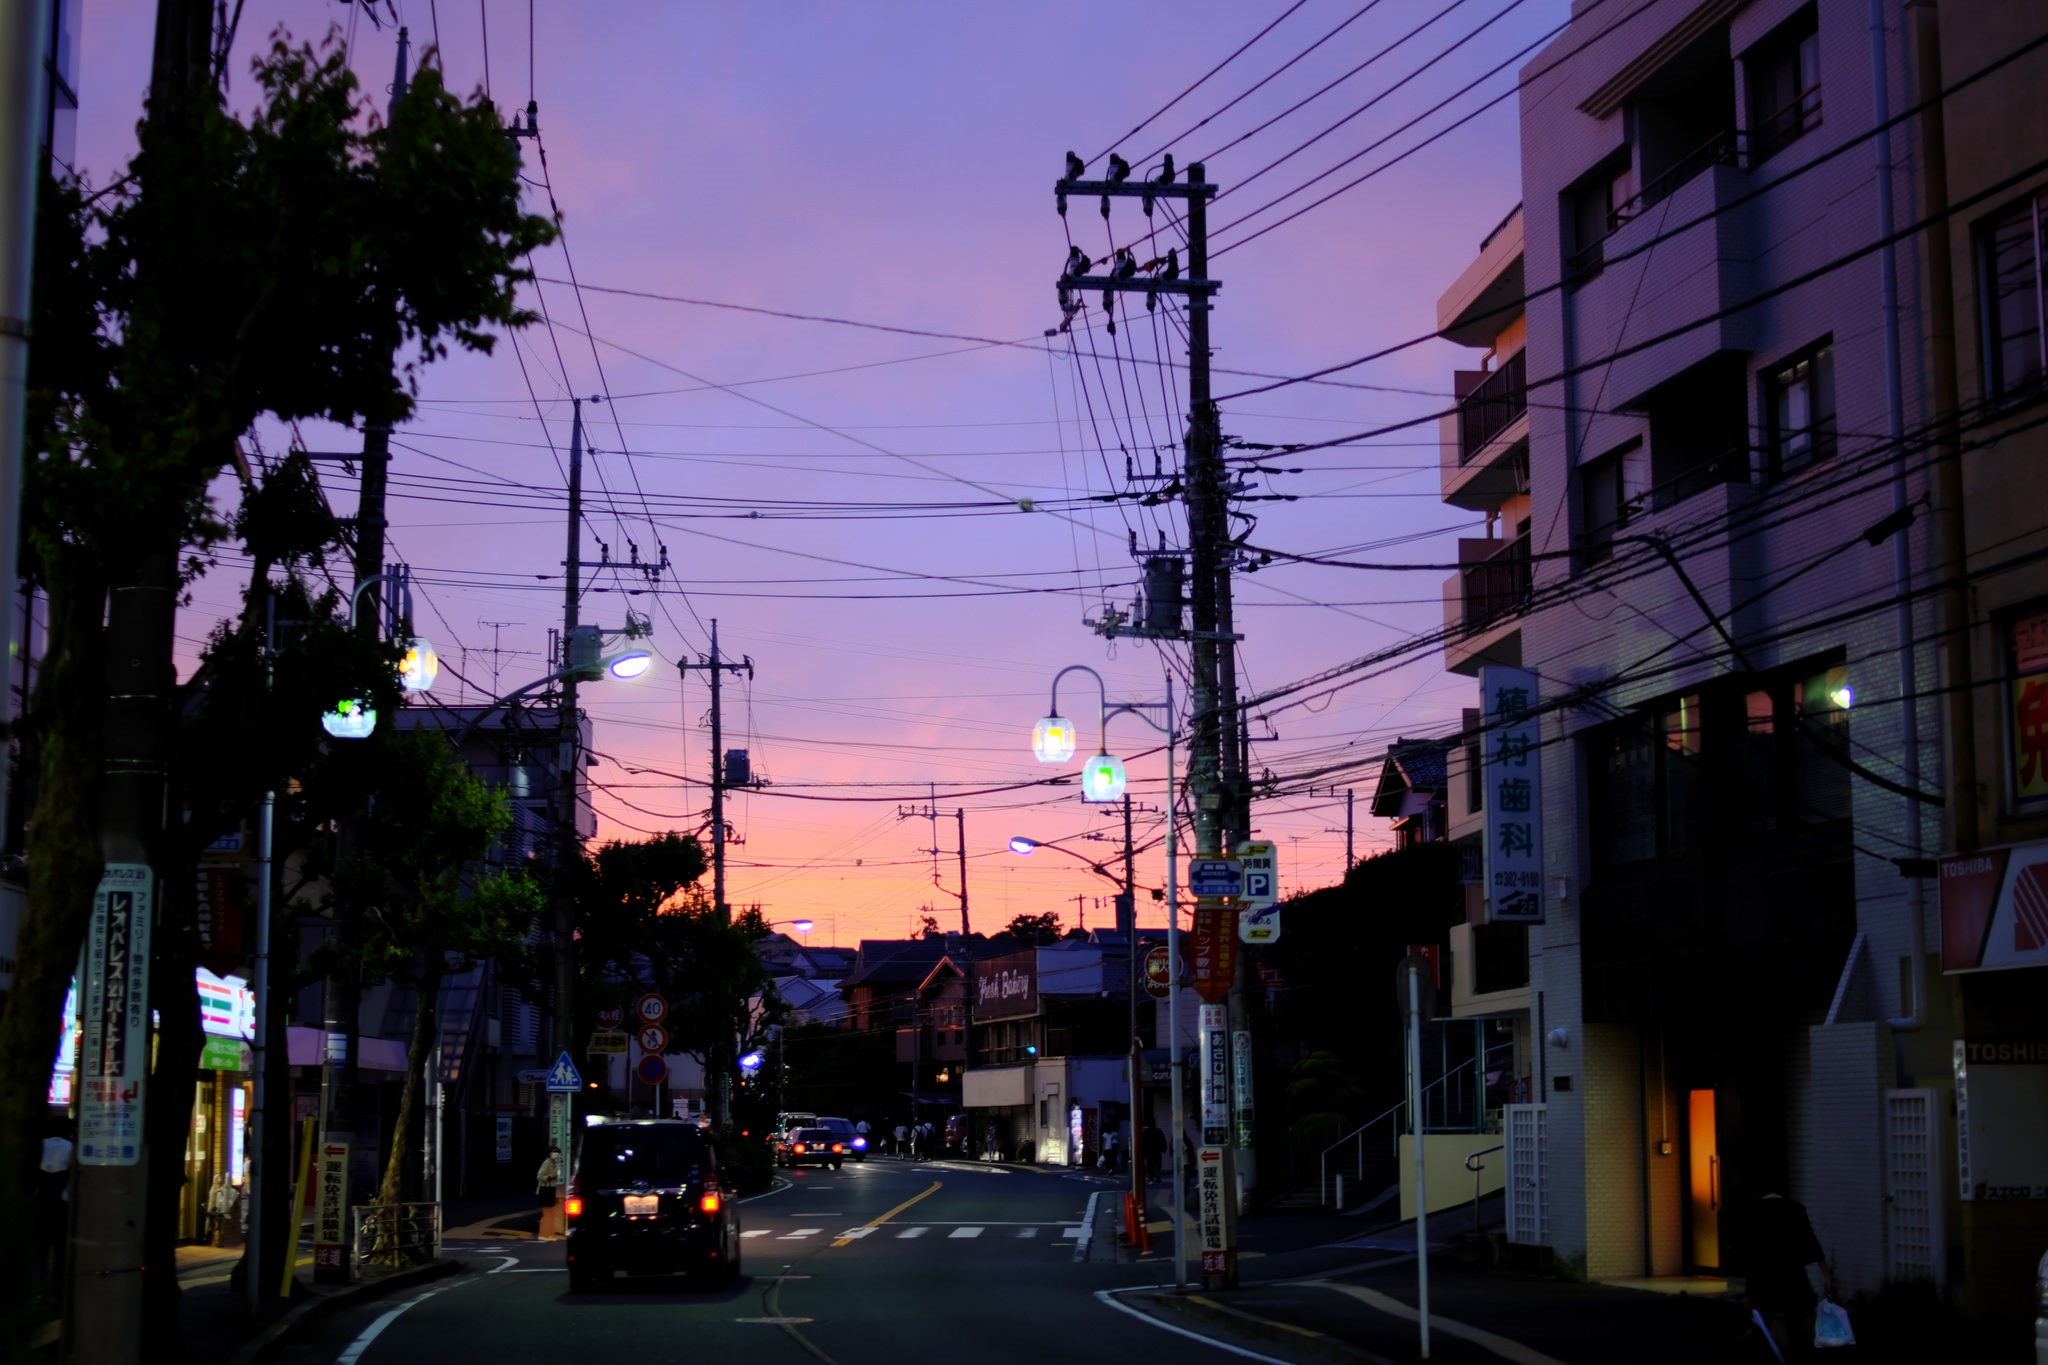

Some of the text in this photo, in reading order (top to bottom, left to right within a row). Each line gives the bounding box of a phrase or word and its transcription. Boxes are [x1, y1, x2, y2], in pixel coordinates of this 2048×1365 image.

[1496, 687, 1533, 858] 植村歯科
[1942, 857, 1993, 878] TOSHIBA
[1520, 900, 1537, 914] 2F
[1148, 958, 1169, 973] 消火
[1002, 968, 1029, 1001] Bakery
[644, 1002, 662, 1015] 40
[322, 1160, 342, 1243] 運転免許試験場
[1203, 1166, 1222, 1249] 運転免許試験場
[317, 1249, 342, 1267] 近道
[1203, 1253, 1227, 1272] 近道
